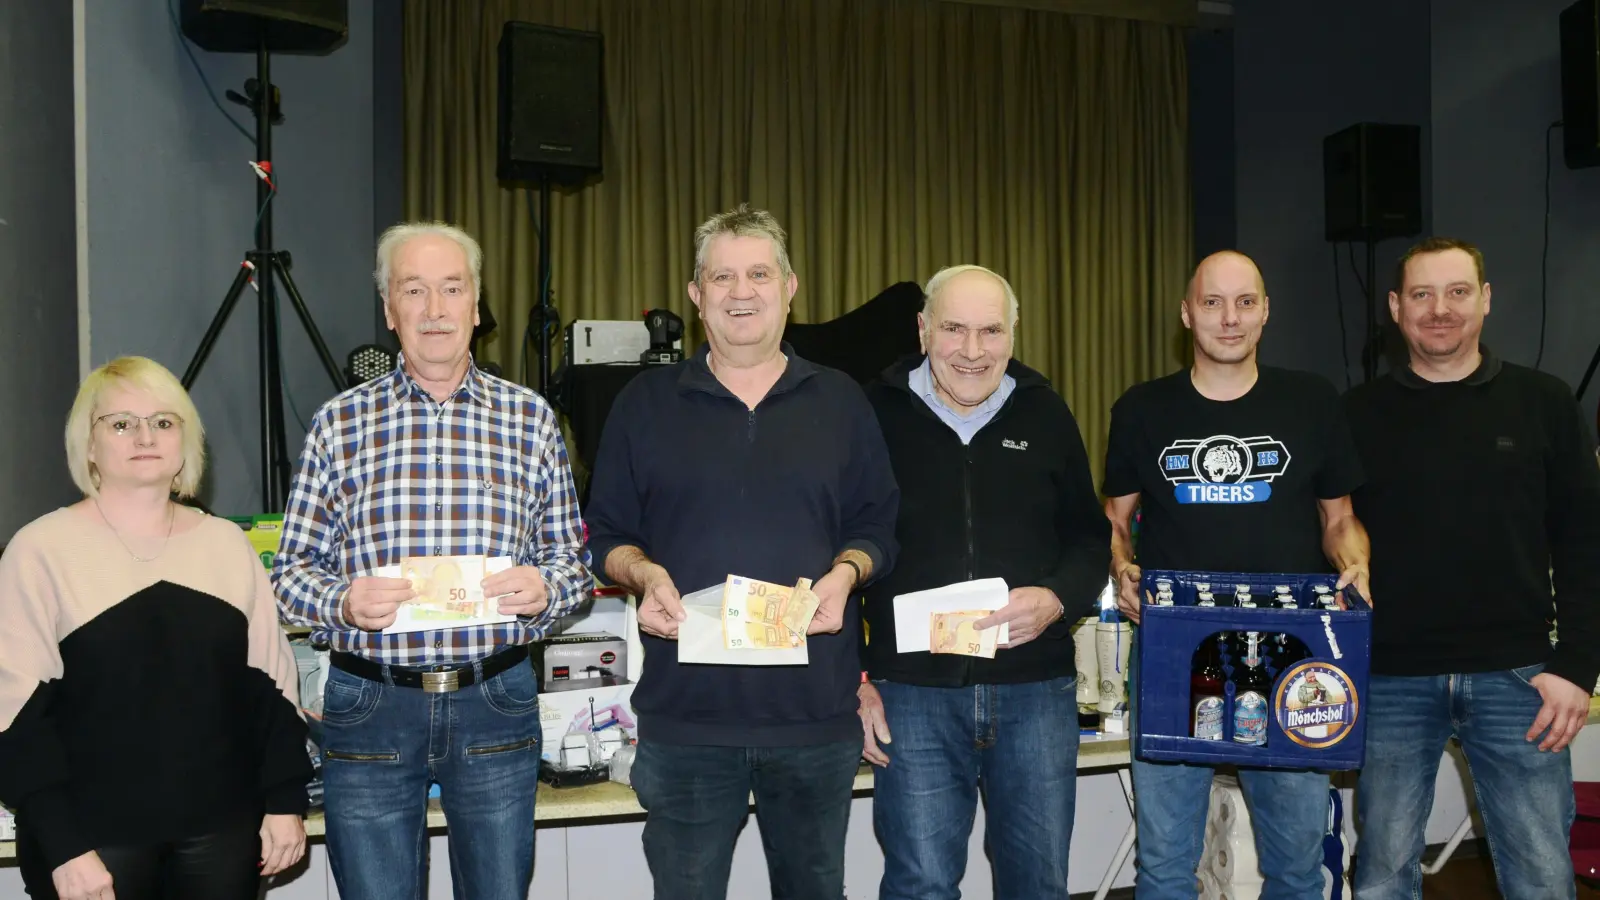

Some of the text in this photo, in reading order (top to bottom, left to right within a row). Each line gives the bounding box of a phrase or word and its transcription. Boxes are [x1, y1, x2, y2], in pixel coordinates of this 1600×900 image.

[1166, 451, 1279, 470] HM HS
[1188, 485, 1255, 502] TIGERS
[449, 588, 467, 600] 50
[748, 582, 767, 597] 50
[728, 608, 739, 617] 50
[731, 638, 742, 647] 50
[968, 643, 981, 654] 50
[1287, 704, 1344, 727] Mönchshof
